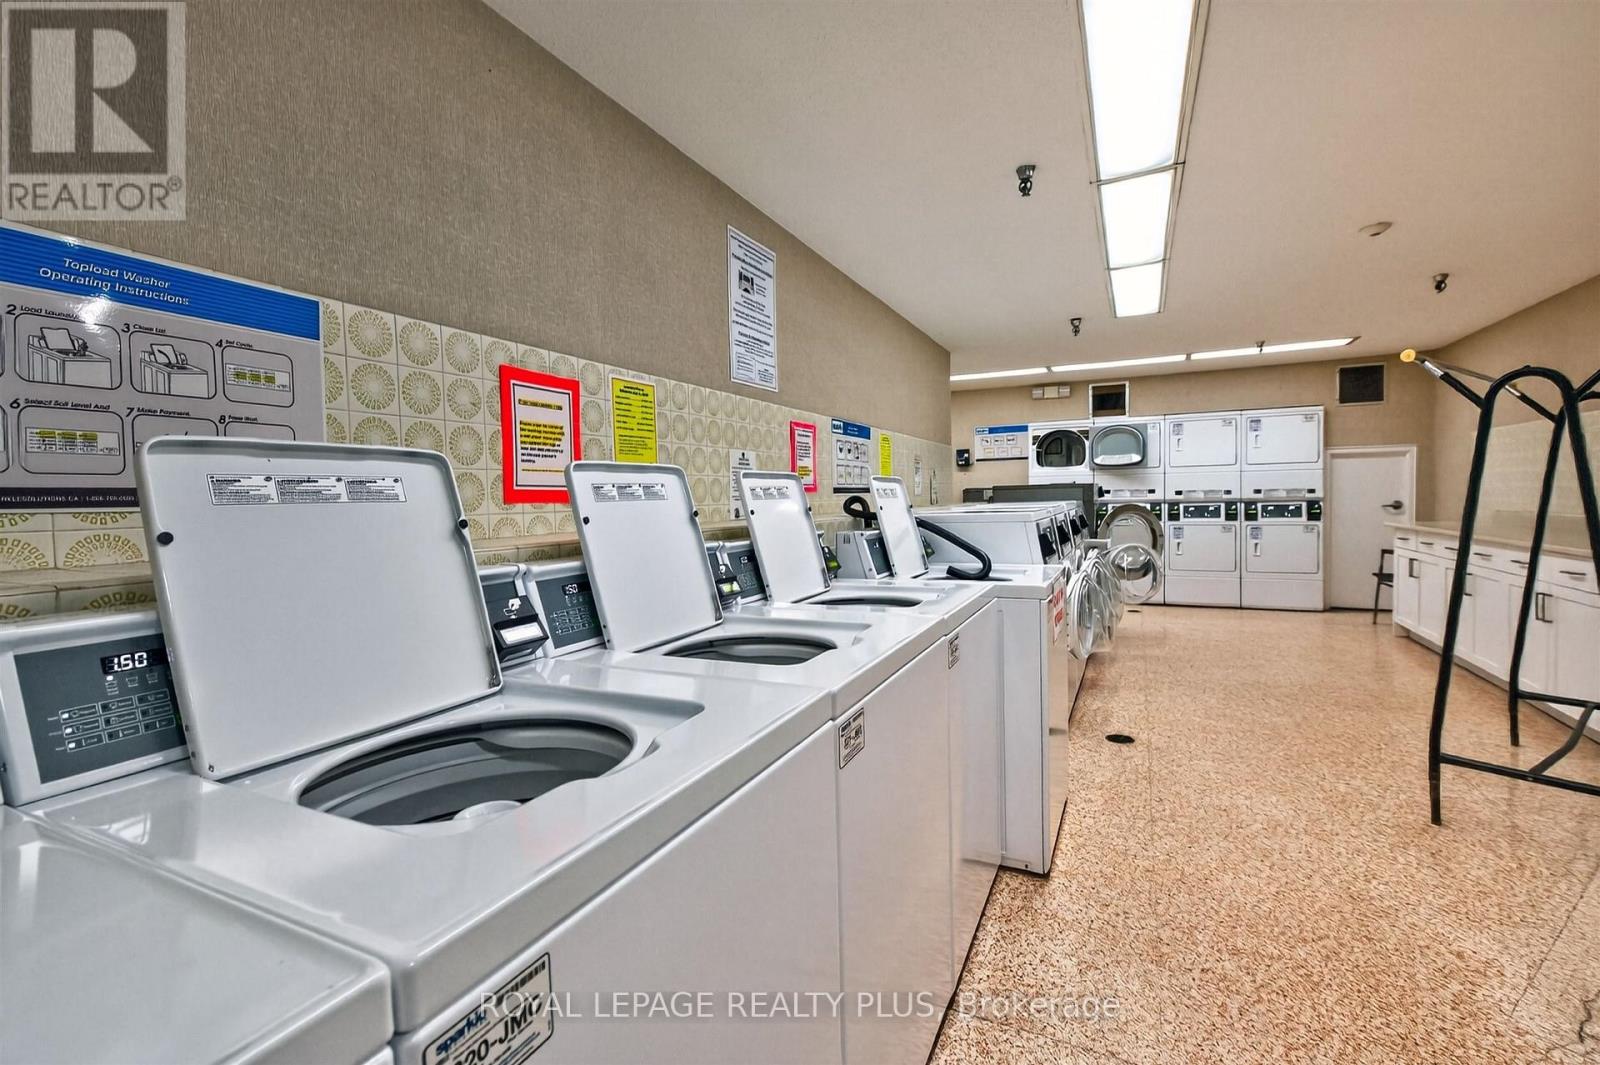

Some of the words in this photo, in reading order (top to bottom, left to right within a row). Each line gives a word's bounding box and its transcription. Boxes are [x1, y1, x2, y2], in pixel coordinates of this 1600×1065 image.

[63, 258, 119, 277] Topload
[123, 271, 171, 289] Washer
[39, 267, 111, 291] Operating
[115, 282, 189, 305] Instructions
[5, 304, 17, 315] 2
[20, 305, 42, 314] Load
[121, 323, 130, 333] 3
[215, 339, 223, 348] 4
[9, 398, 21, 409] 6
[125, 407, 135, 417] 7
[218, 415, 226, 424] 8
